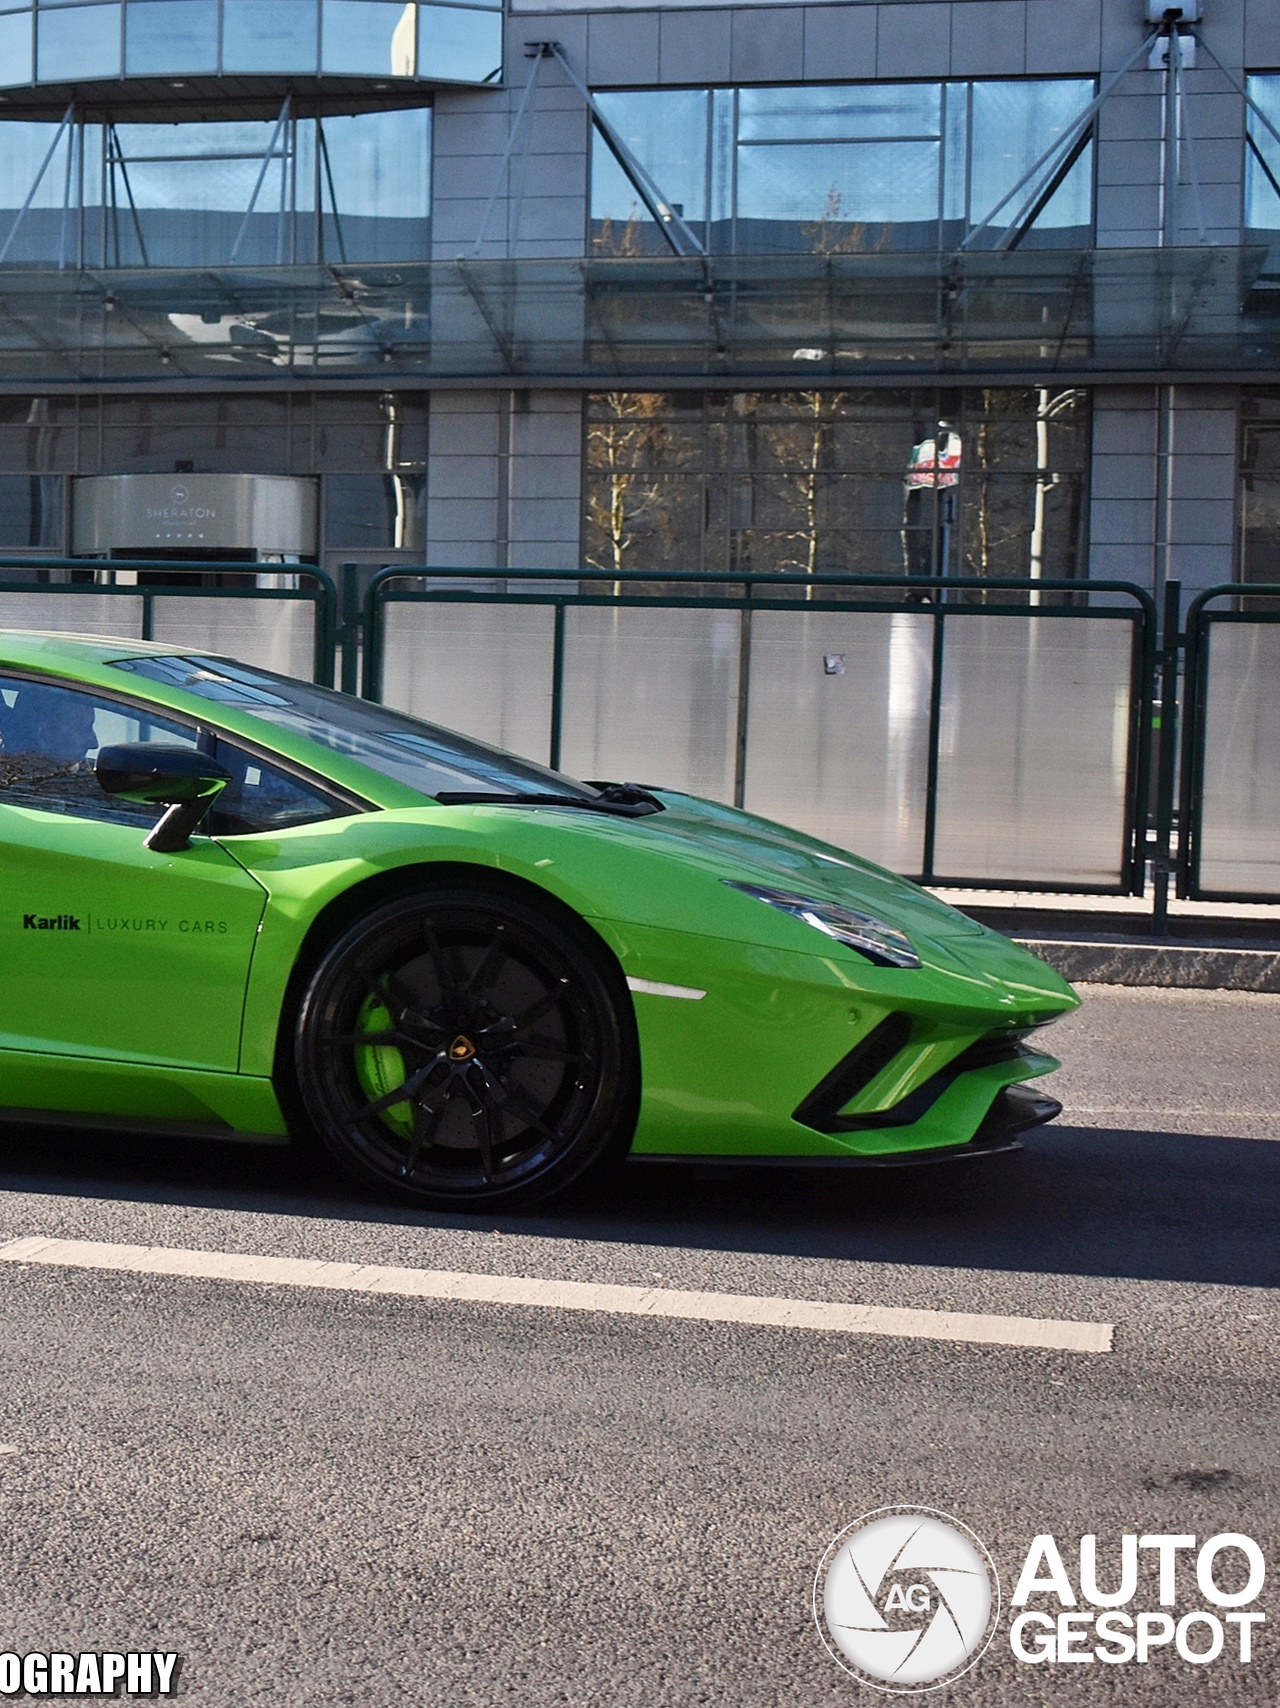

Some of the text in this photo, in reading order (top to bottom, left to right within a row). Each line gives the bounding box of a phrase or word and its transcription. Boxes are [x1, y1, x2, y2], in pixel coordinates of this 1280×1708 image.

[146, 507, 216, 519] SHERATON
[23, 913, 228, 934] Karlik LUXURY CARS
